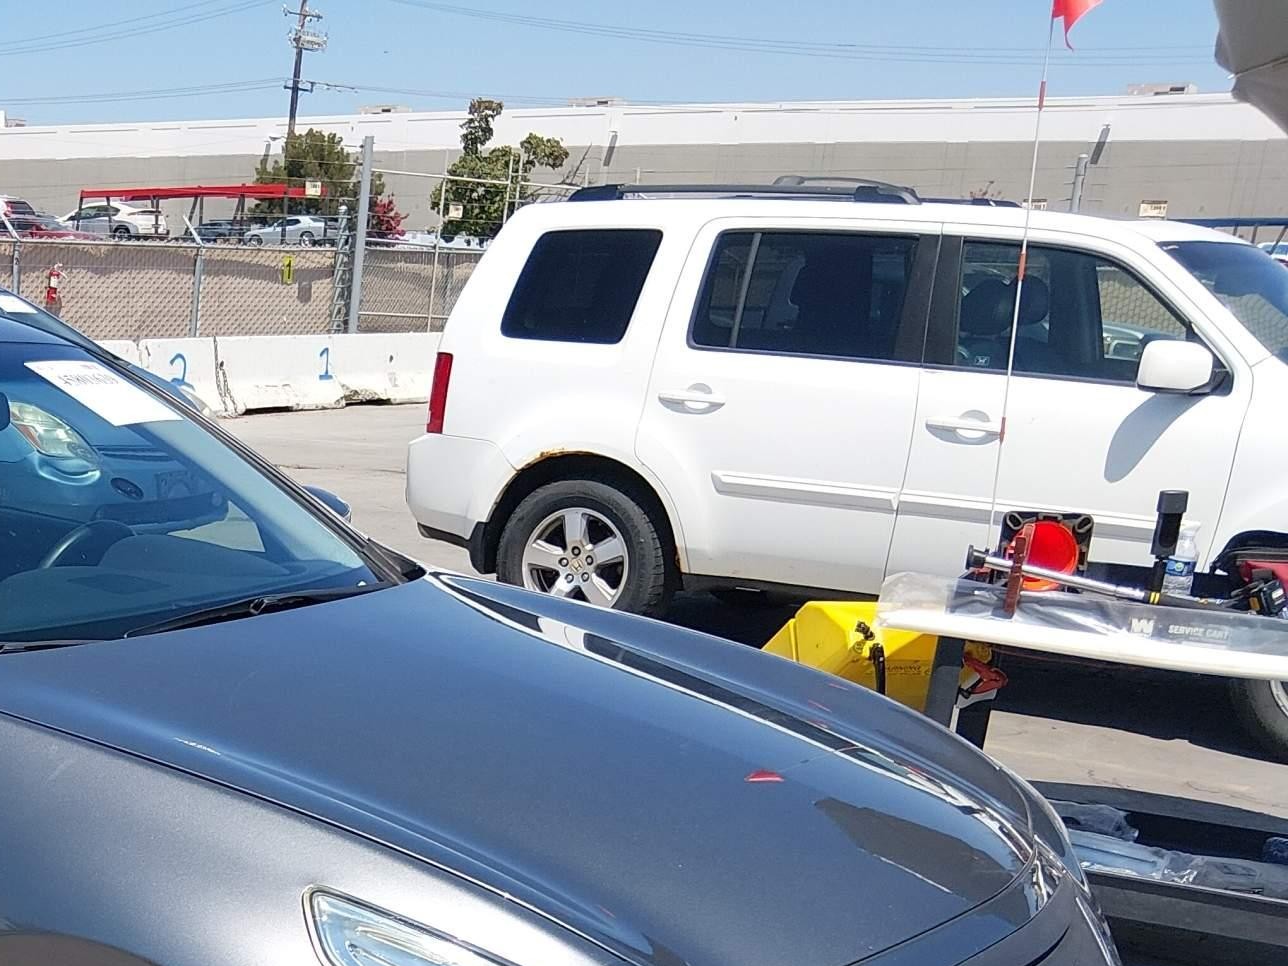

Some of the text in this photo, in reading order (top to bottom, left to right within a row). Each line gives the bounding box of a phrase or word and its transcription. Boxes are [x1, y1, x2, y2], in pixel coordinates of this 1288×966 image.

[286, 259, 292, 280] 1
[170, 353, 194, 388] 2
[319, 347, 333, 381] 1
[1168, 624, 1230, 641] SERVICE CART
